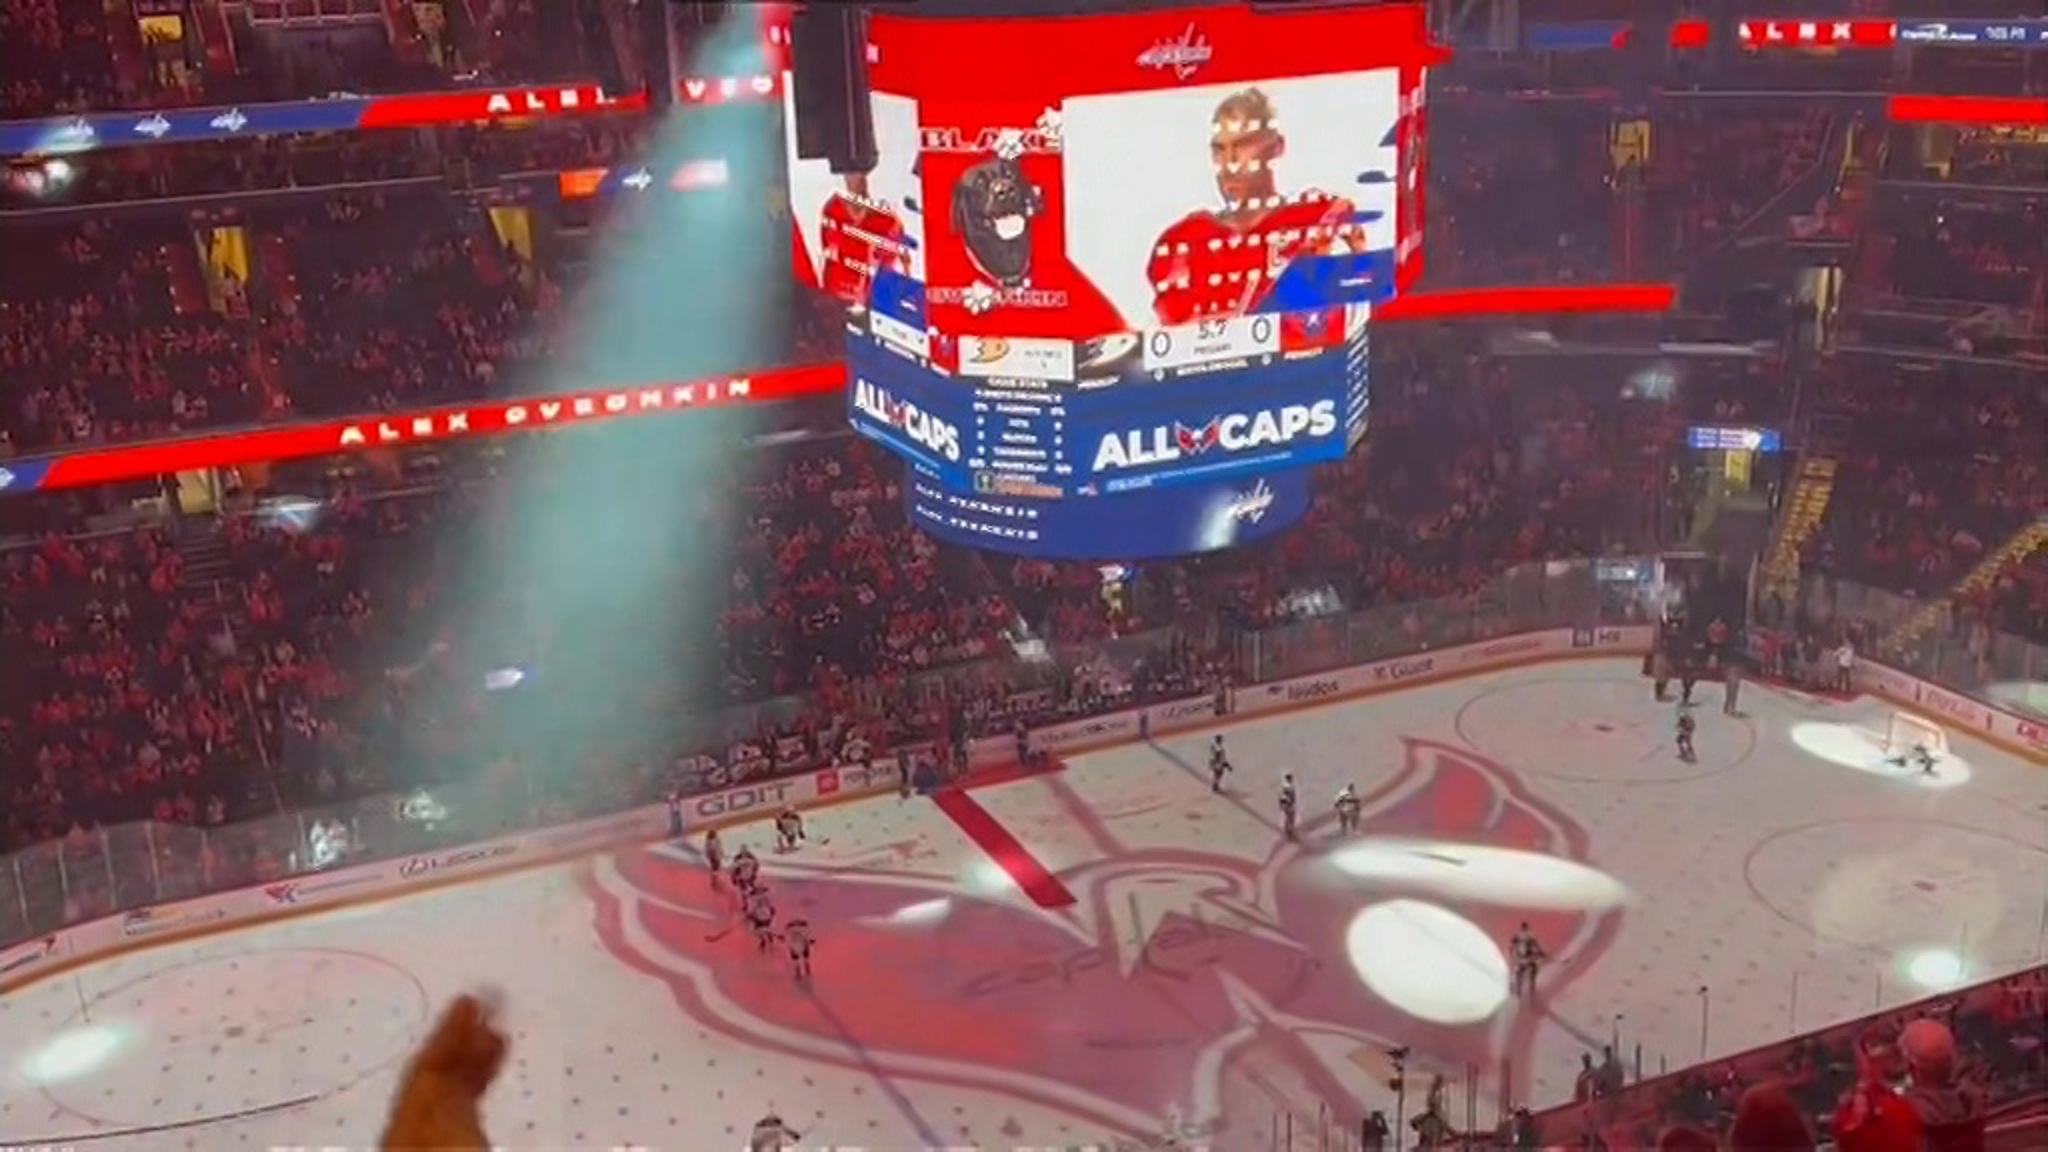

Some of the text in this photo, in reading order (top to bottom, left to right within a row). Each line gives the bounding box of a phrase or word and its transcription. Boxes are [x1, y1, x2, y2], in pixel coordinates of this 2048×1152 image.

[1151, 331, 1171, 358] 0
[1251, 316, 1271, 343] 0
[341, 411, 468, 445] ALEX
[855, 378, 891, 424] ALL
[904, 402, 960, 462] CAPS
[1092, 426, 1180, 472] ALL
[1219, 399, 1337, 450] CAPS
[696, 780, 794, 816] GDIT
